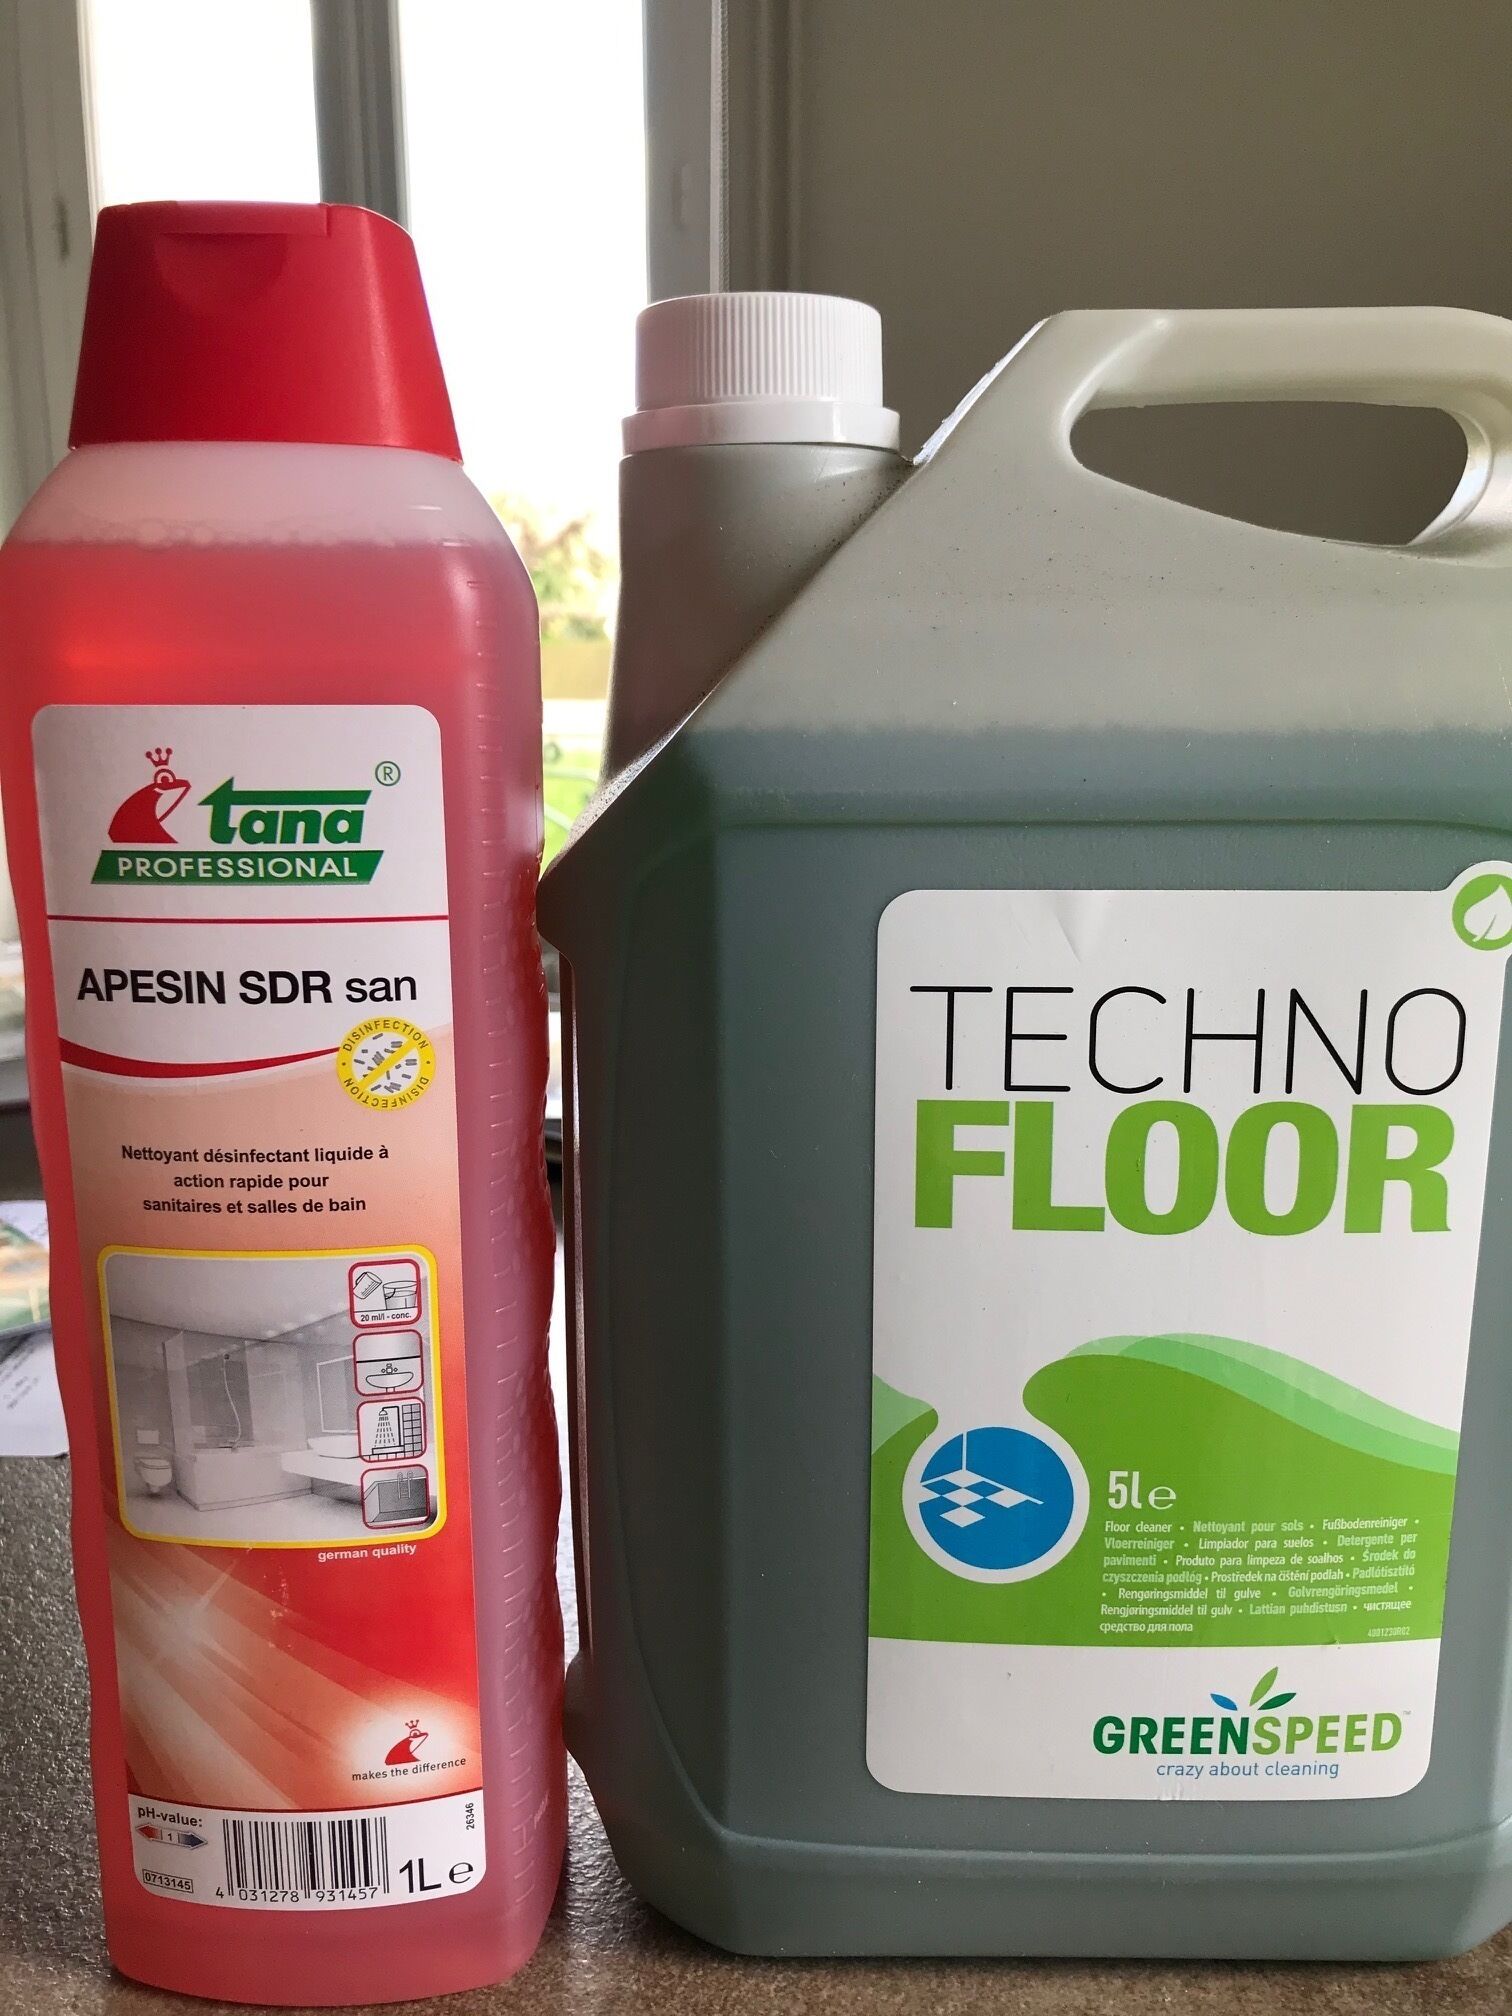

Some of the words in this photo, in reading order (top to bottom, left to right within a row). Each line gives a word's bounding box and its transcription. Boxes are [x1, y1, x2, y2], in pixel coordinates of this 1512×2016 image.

[197, 777, 372, 845] tana
[118, 857, 357, 878] PROFESSIONAL
[77, 968, 226, 1004] APESIN
[239, 970, 332, 1004] SDR
[345, 975, 417, 1002] san
[343, 1020, 428, 1051] DISINFECTION
[910, 986, 1466, 1095] TECHNO
[344, 1077, 429, 1108] DISINFECTION
[121, 1145, 198, 1164] Nettoyant
[204, 1149, 309, 1163] désinfectant
[315, 1147, 373, 1165] liquide
[379, 1145, 389, 1159] à
[914, 1099, 1455, 1236] FLOOR
[174, 1174, 224, 1188] action
[229, 1174, 283, 1191] rapide
[289, 1175, 329, 1191] pour
[143, 1199, 222, 1213] sanitaires
[227, 1201, 243, 1214] et
[247, 1200, 297, 1213] salles
[303, 1199, 324, 1212] de
[329, 1197, 366, 1212] bain
[361, 1314, 369, 1322] 20
[1108, 1470, 1141, 1510] 5l
[1105, 1520, 1130, 1532] Floor
[1136, 1520, 1172, 1532] cleaner
[1193, 1520, 1245, 1534] Nettoyant
[1251, 1521, 1276, 1534] pour
[1281, 1519, 1304, 1532] sols
[1322, 1516, 1408, 1531] Fußbodenreiniger
[1104, 1537, 1175, 1551] Vloerreiniger
[1199, 1537, 1249, 1551] Limpiador
[1254, 1539, 1277, 1551] para
[1283, 1536, 1314, 1548] suelos
[1337, 1534, 1394, 1548] Detergente
[1401, 1533, 1418, 1546] per
[318, 1549, 368, 1562] german
[372, 1544, 416, 1559] quality
[1103, 1554, 1157, 1568] pavimenti
[1176, 1555, 1215, 1566] Produto
[1220, 1556, 1242, 1568] para
[1247, 1553, 1285, 1567] limpeza
[1290, 1553, 1303, 1565] de
[1307, 1552, 1344, 1564] soalhos
[1362, 1549, 1399, 1562] Środek
[1404, 1549, 1416, 1560] do
[1102, 1571, 1164, 1584] czyszczenia
[1166, 1571, 1202, 1585] podłóg
[1211, 1570, 1263, 1582] Prostředek
[1265, 1572, 1277, 1582] na
[1310, 1568, 1344, 1583] podlah
[1352, 1565, 1415, 1579] Padlótisztító
[1118, 1587, 1208, 1602] Rengøringsmiddel
[1216, 1588, 1226, 1599] til
[1234, 1587, 1261, 1601] gulve
[1288, 1582, 1398, 1599] Golvrengöringsmedel
[1100, 1604, 1193, 1617] Rengjøringsmiddel
[1197, 1604, 1207, 1615] til
[1211, 1604, 1233, 1617] gulv
[1250, 1602, 1285, 1615] Lattian
[1363, 1601, 1412, 1612] чистящее
[1100, 1622, 1146, 1634] средство
[1147, 1623, 1167, 1633] для
[1168, 1622, 1193, 1632] пола
[1092, 1712, 1403, 1754] GREENSPEED
[352, 1770, 388, 1781] makes
[391, 1767, 409, 1777] the
[412, 1758, 467, 1774] difference
[1156, 1762, 1204, 1779] crazy
[1209, 1761, 1259, 1776] about
[1265, 1760, 1339, 1779] cleaning
[137, 1806, 203, 1827] pH-value:
[465, 1802, 475, 1831] 26346
[144, 1872, 191, 1890] 0713145
[399, 1858, 442, 1894] 1L
[215, 1887, 224, 1899] 4
[239, 1888, 300, 1902] 031278
[316, 1887, 378, 1902] 931457
